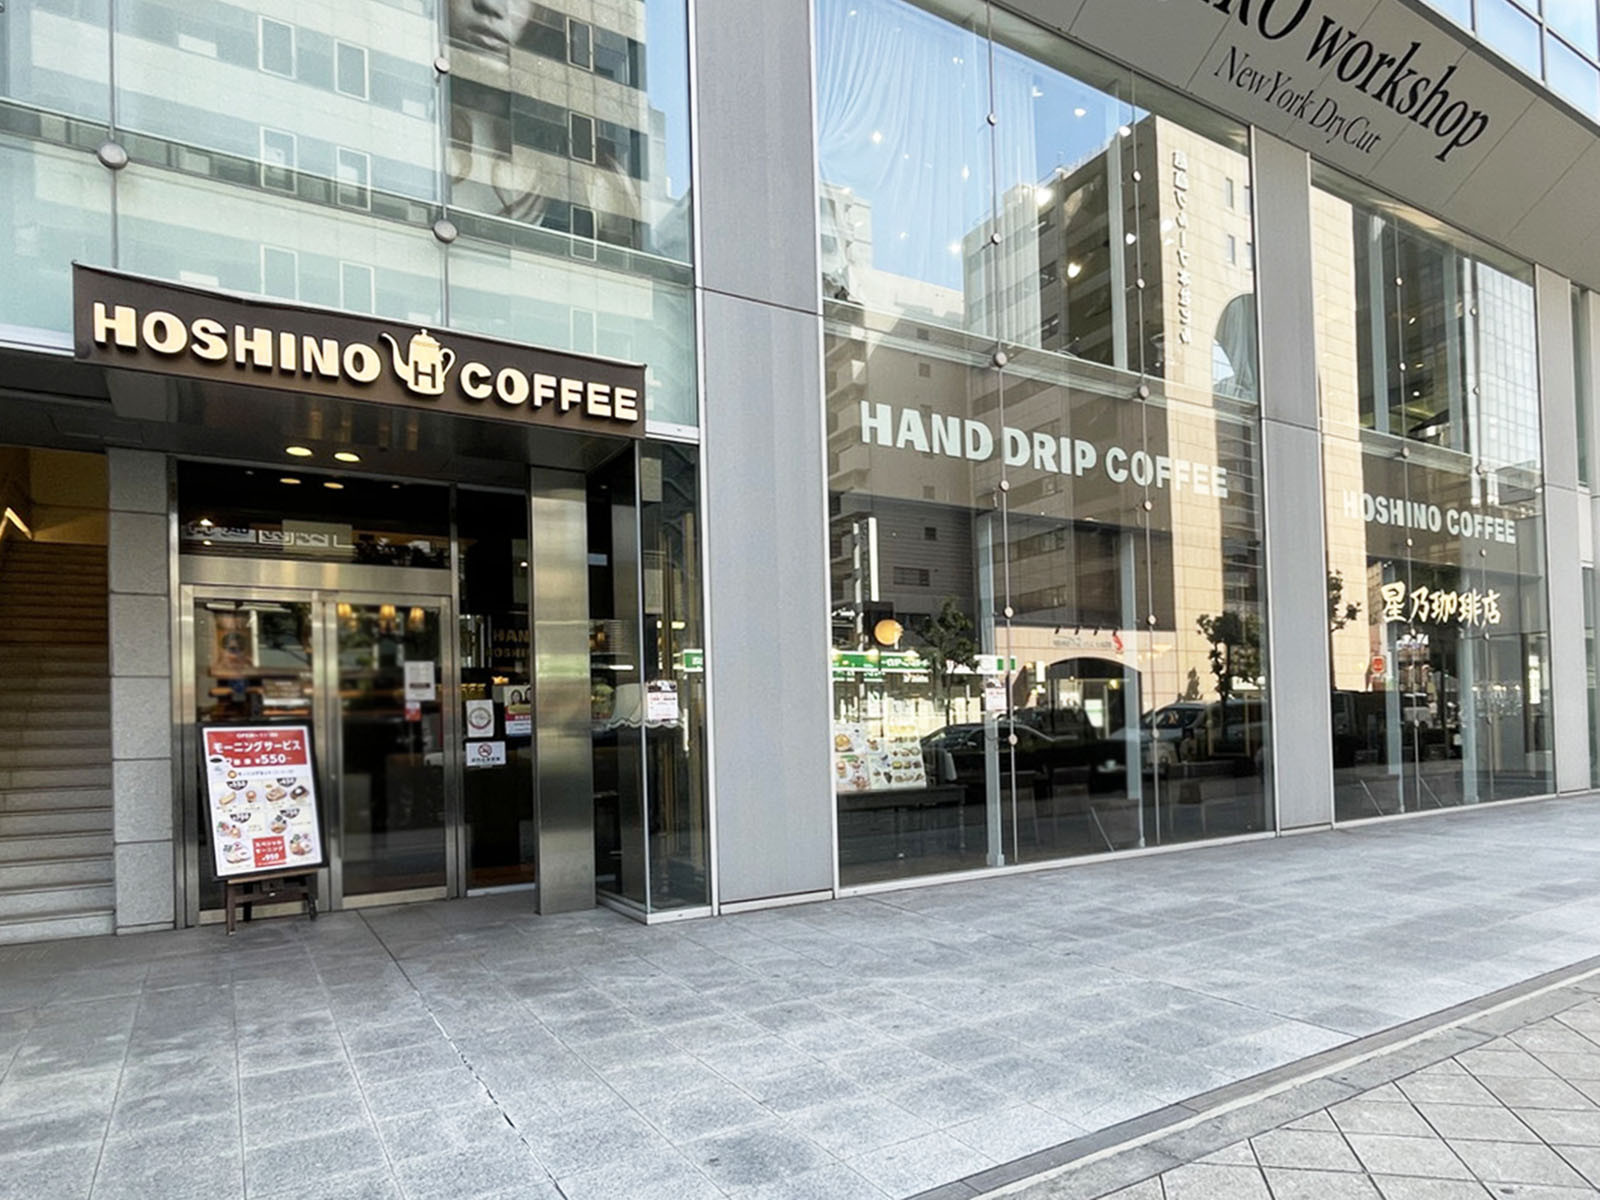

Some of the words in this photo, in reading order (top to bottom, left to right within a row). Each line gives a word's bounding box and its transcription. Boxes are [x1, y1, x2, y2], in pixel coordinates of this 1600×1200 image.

[1306, 15, 1489, 163] workshop
[93, 302, 381, 383] HOSHINO
[461, 362, 638, 422] COFFEE
[860, 400, 993, 461] HAND
[1002, 426, 1097, 477] DRIP
[1105, 446, 1229, 498] COFFEE
[1344, 490, 1441, 532] HOSHINO
[1446, 509, 1516, 544] COFFEE
[1381, 580, 1502, 629] 星乃珈琲店
[213, 740, 301, 754] モーニングサービス
